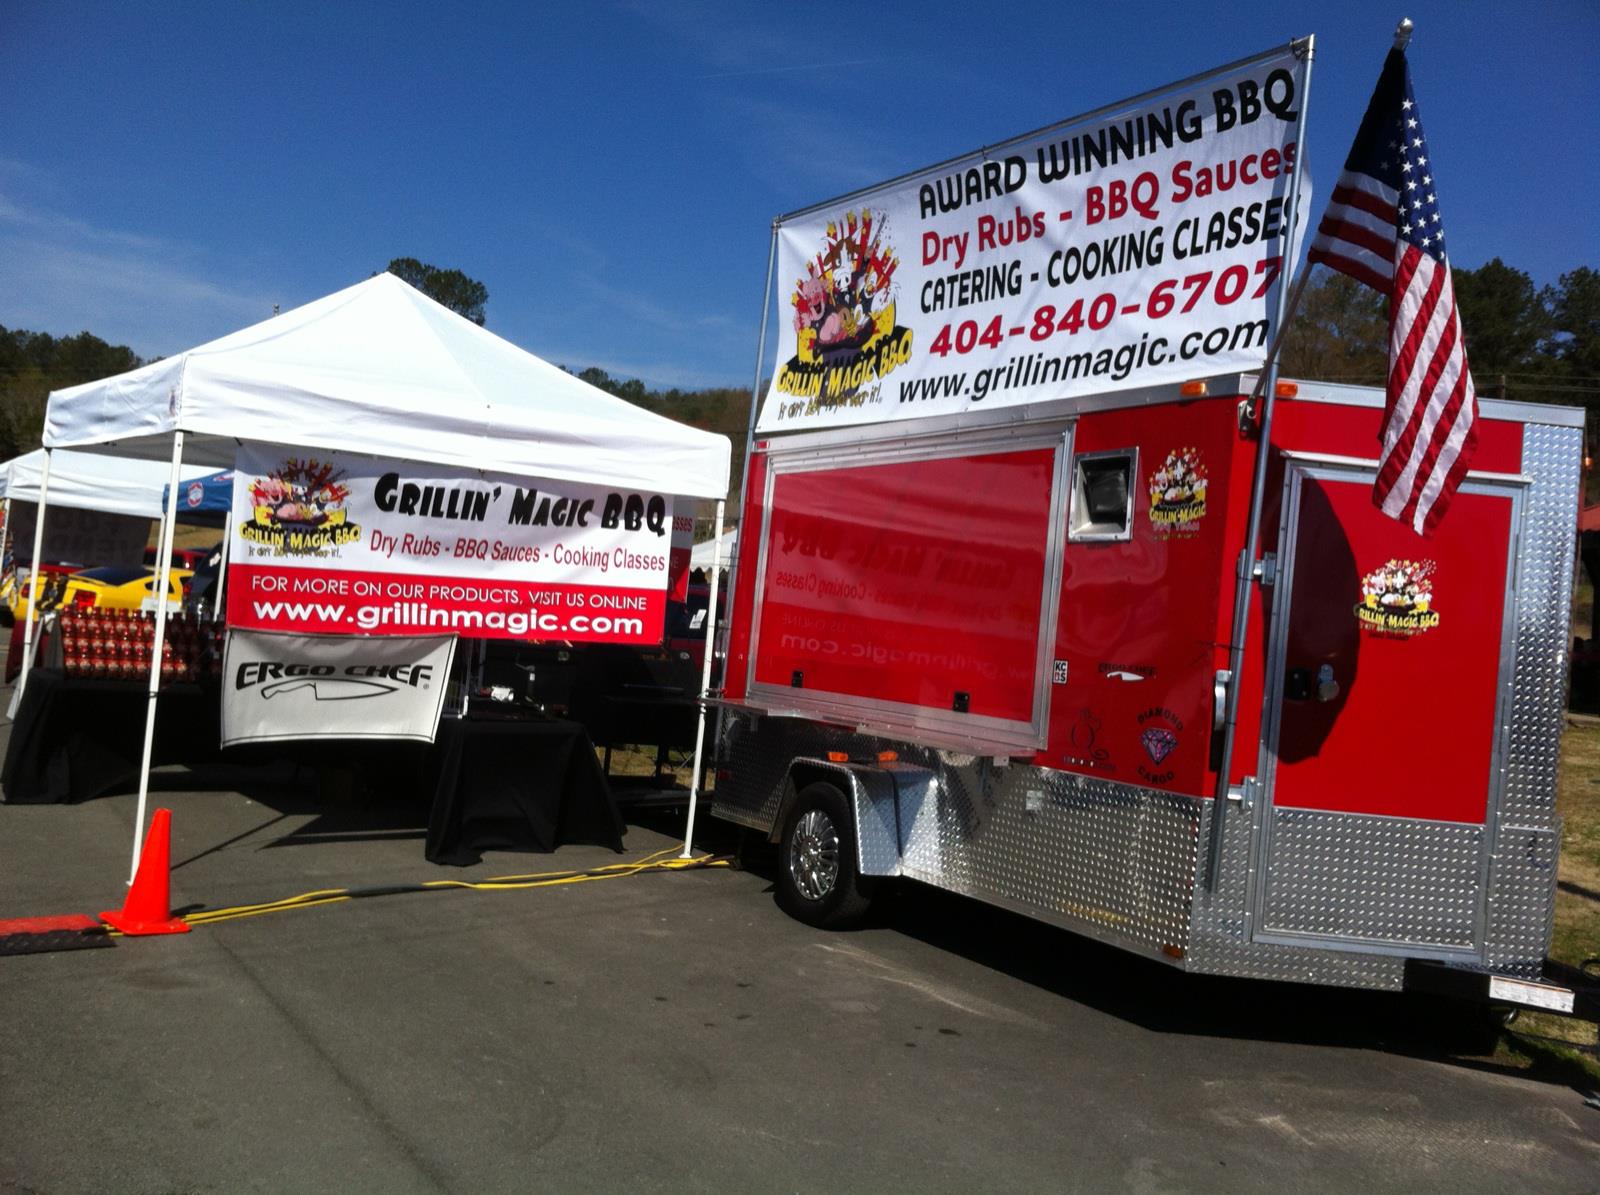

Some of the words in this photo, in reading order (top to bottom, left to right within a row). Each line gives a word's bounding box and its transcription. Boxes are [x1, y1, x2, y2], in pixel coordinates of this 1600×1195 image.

[919, 154, 1027, 220] AWARD
[1036, 98, 1203, 184] WINNING
[1211, 68, 1298, 134] BBQ
[922, 231, 969, 270] Dry
[978, 206, 1046, 252] Rubs
[1086, 171, 1160, 226] BBQ
[1171, 142, 1297, 203] Sauces
[920, 259, 1022, 314] CATERING
[1047, 226, 1164, 288] COOKING
[929, 255, 1284, 357] 404-840-6707
[827, 355, 877, 398] MAGIC
[879, 329, 913, 380] BBQ
[899, 318, 1270, 403] www.grillinmagic.com
[508, 487, 596, 528] MAGIC
[600, 492, 666, 537] BBQ
[290, 532, 331, 550] MAGIC
[335, 524, 361, 545] BBQ
[371, 529, 398, 558] Dry
[401, 532, 441, 556] Rubs
[453, 537, 489, 560] BBQ
[491, 540, 540, 562] Sauces
[553, 543, 609, 573] Cooking
[613, 547, 666, 571] Classes
[252, 575, 288, 592] FOR
[293, 578, 349, 595] MORE
[353, 581, 382, 596] ON
[386, 582, 425, 599] OUR
[528, 591, 562, 606] VISIT
[566, 593, 585, 607] US
[589, 594, 647, 611] ONLINE
[253, 601, 643, 635] www.grillinmagic.com
[1388, 614, 1419, 628] MAGIC
[235, 661, 337, 691] ERGO
[343, 663, 433, 687] CHEF
[1056, 663, 1066, 672] KC
[1137, 706, 1184, 731] DIAMOND
[1137, 765, 1174, 784] CARGO
